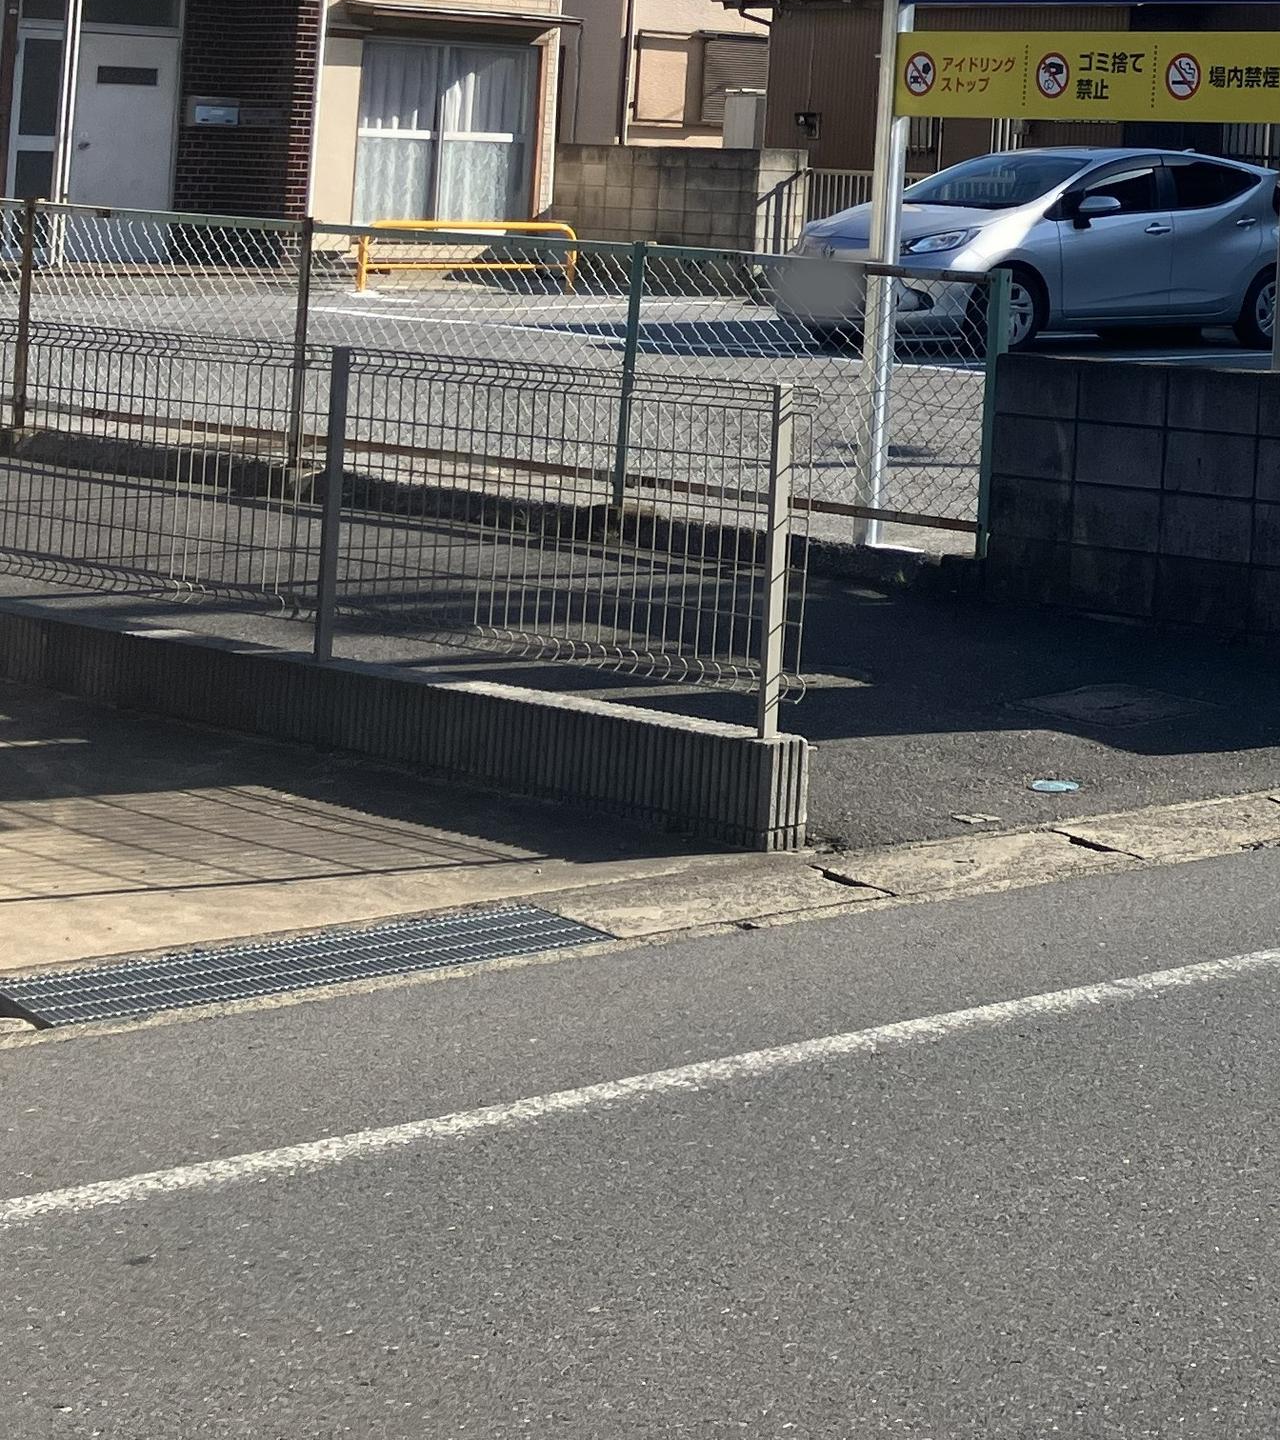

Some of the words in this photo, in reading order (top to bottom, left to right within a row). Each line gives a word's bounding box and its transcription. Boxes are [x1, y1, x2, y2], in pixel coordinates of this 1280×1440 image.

[941, 57, 1016, 73] アイドリング
[1079, 52, 1145, 74] ゴミ捨て
[941, 76, 991, 93] ストップ
[1208, 65, 1280, 89] 場内禁煙
[1076, 79, 1109, 101] 禁止
